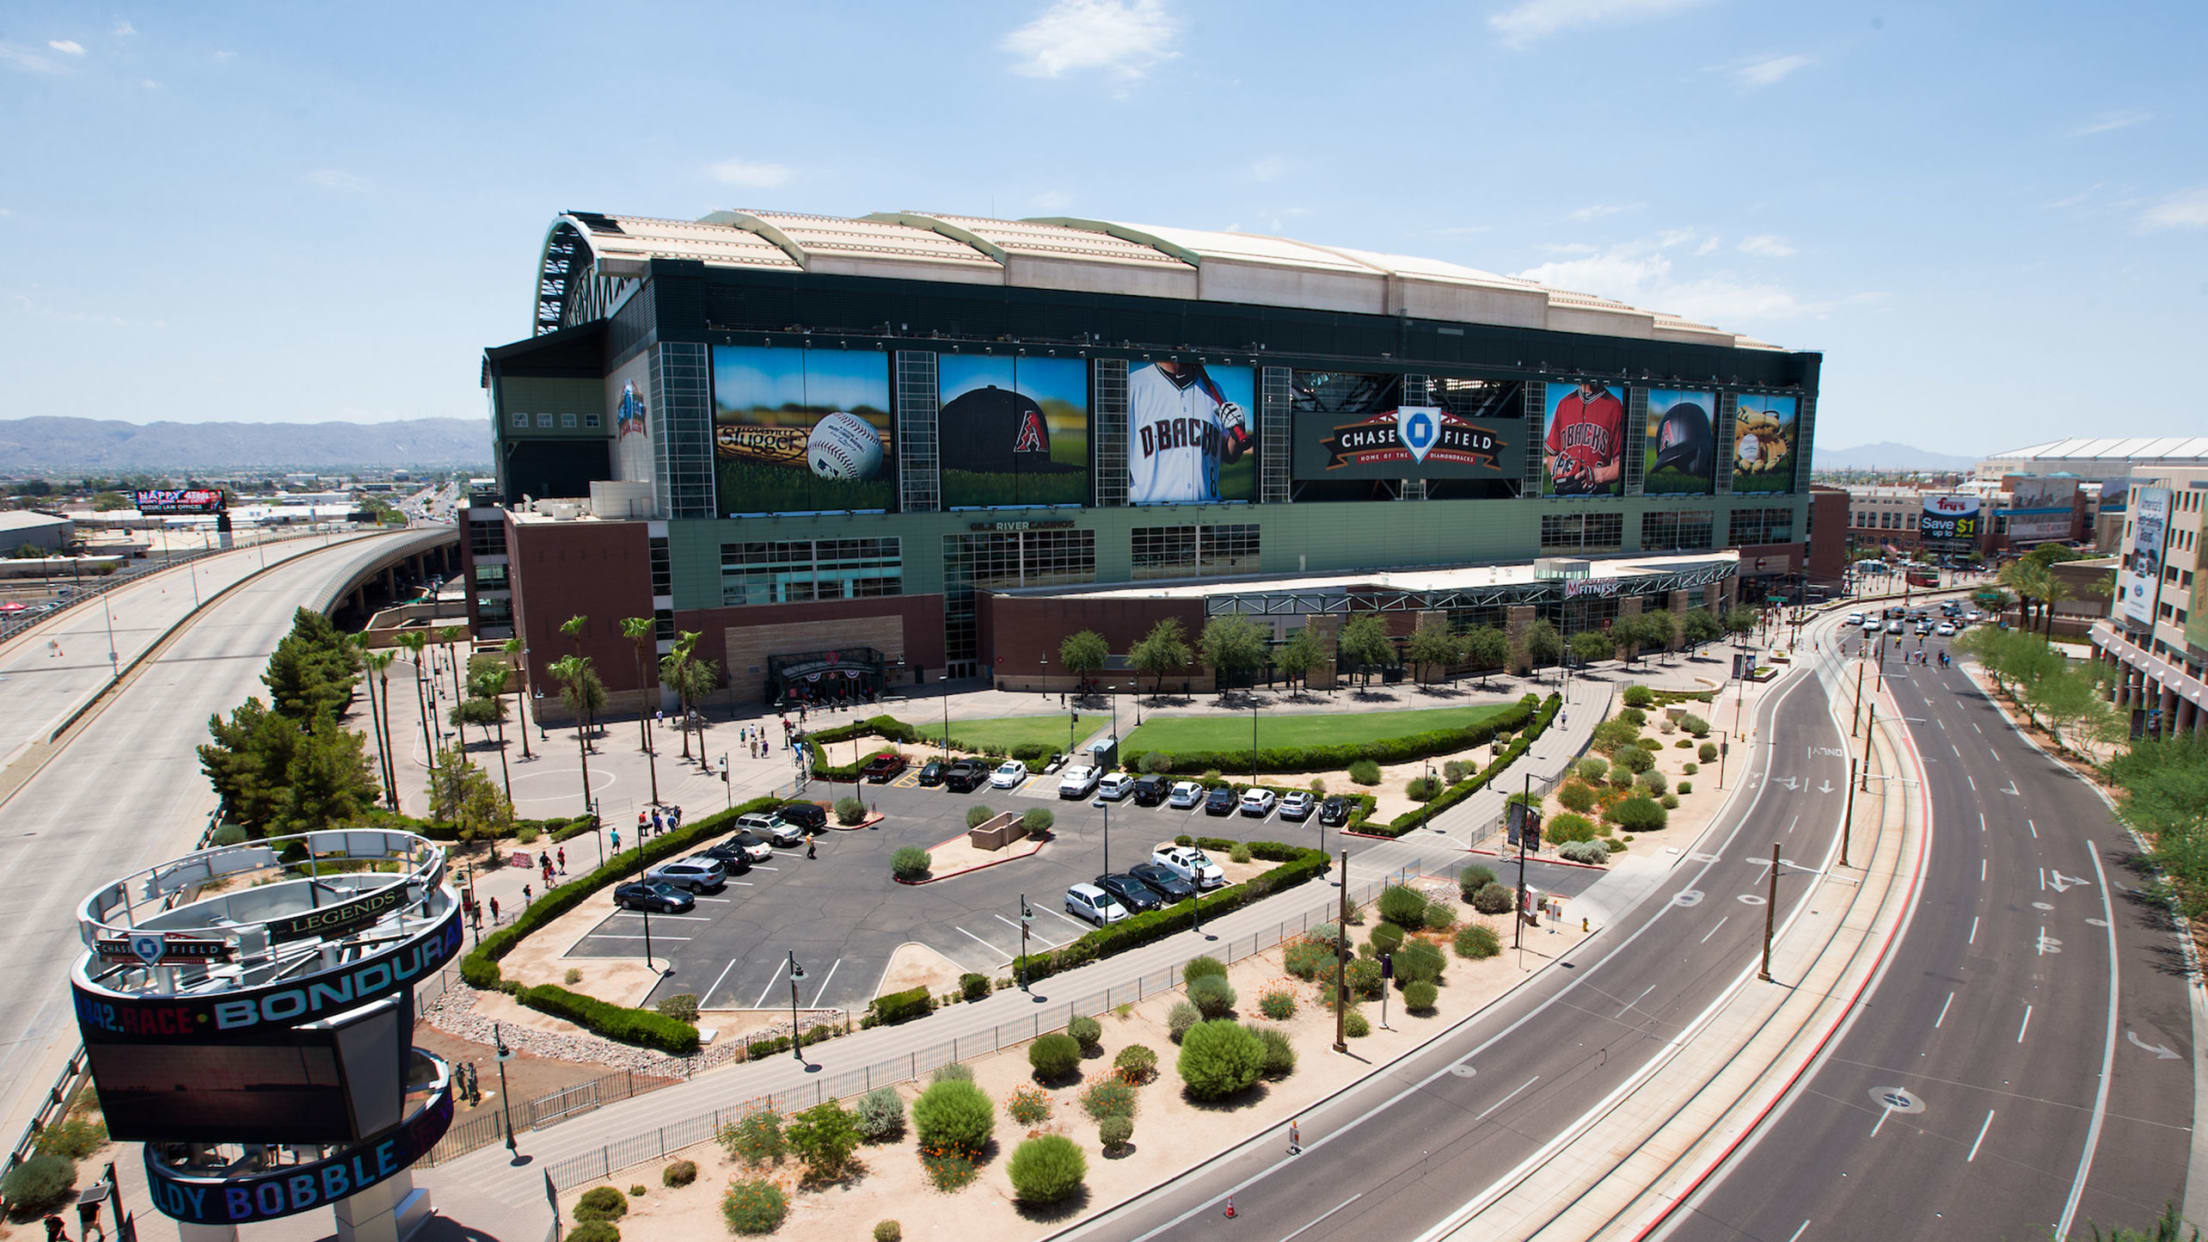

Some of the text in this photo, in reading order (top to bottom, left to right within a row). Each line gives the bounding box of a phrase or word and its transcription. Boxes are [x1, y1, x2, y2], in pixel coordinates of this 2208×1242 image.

[721, 427, 800, 455] Slugger
[1341, 429, 1492, 450] CHASE FIELD
[1360, 453, 1379, 462] HOME
[1430, 453, 1474, 463] DIAMONDBACKS
[137, 490, 185, 500] HAPPY
[996, 520, 1030, 531] RIVER
[1921, 517, 1975, 534] Save $1
[1579, 583, 1618, 595] FITNESS
[291, 891, 396, 935] LEGENDS
[171, 943, 219, 955] FIELD
[225, 1139, 398, 1220] BOBBLE
